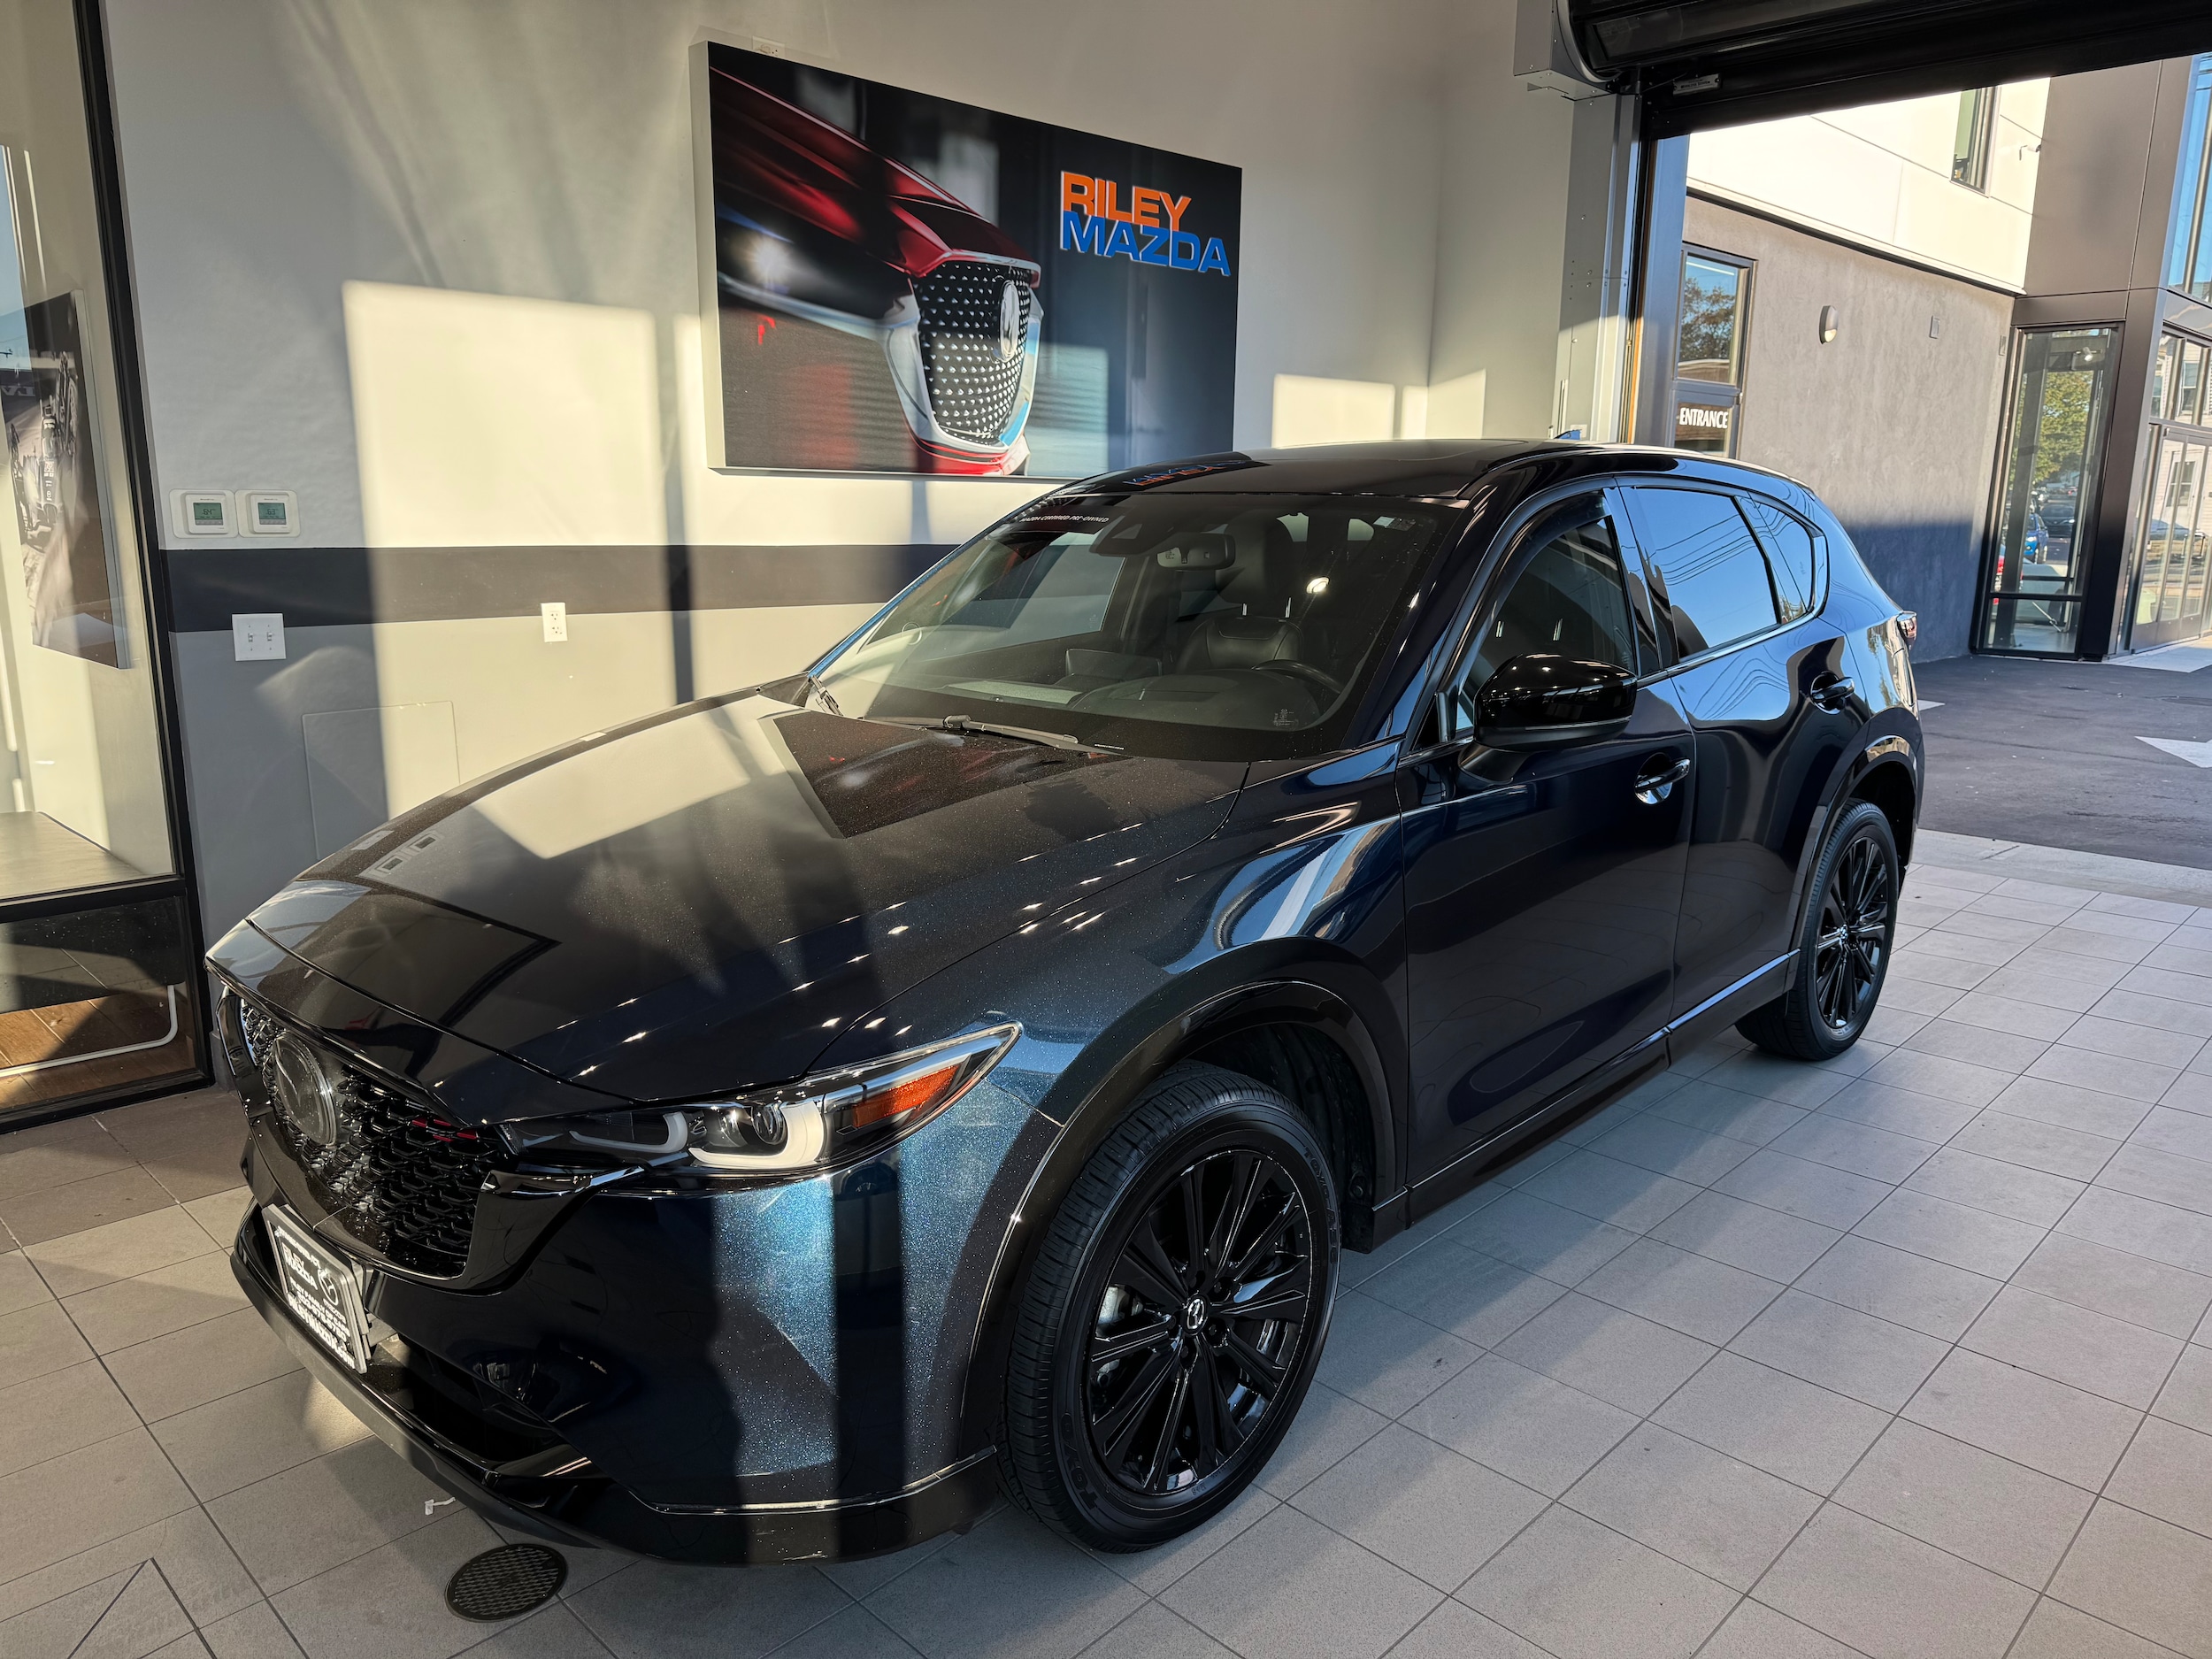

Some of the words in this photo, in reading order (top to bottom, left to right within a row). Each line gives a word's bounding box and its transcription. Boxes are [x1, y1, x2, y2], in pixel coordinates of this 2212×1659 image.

[1061, 171, 1192, 232] RILEY
[1060, 209, 1231, 277] MAZDA
[1679, 407, 1729, 429] ENTRANCE
